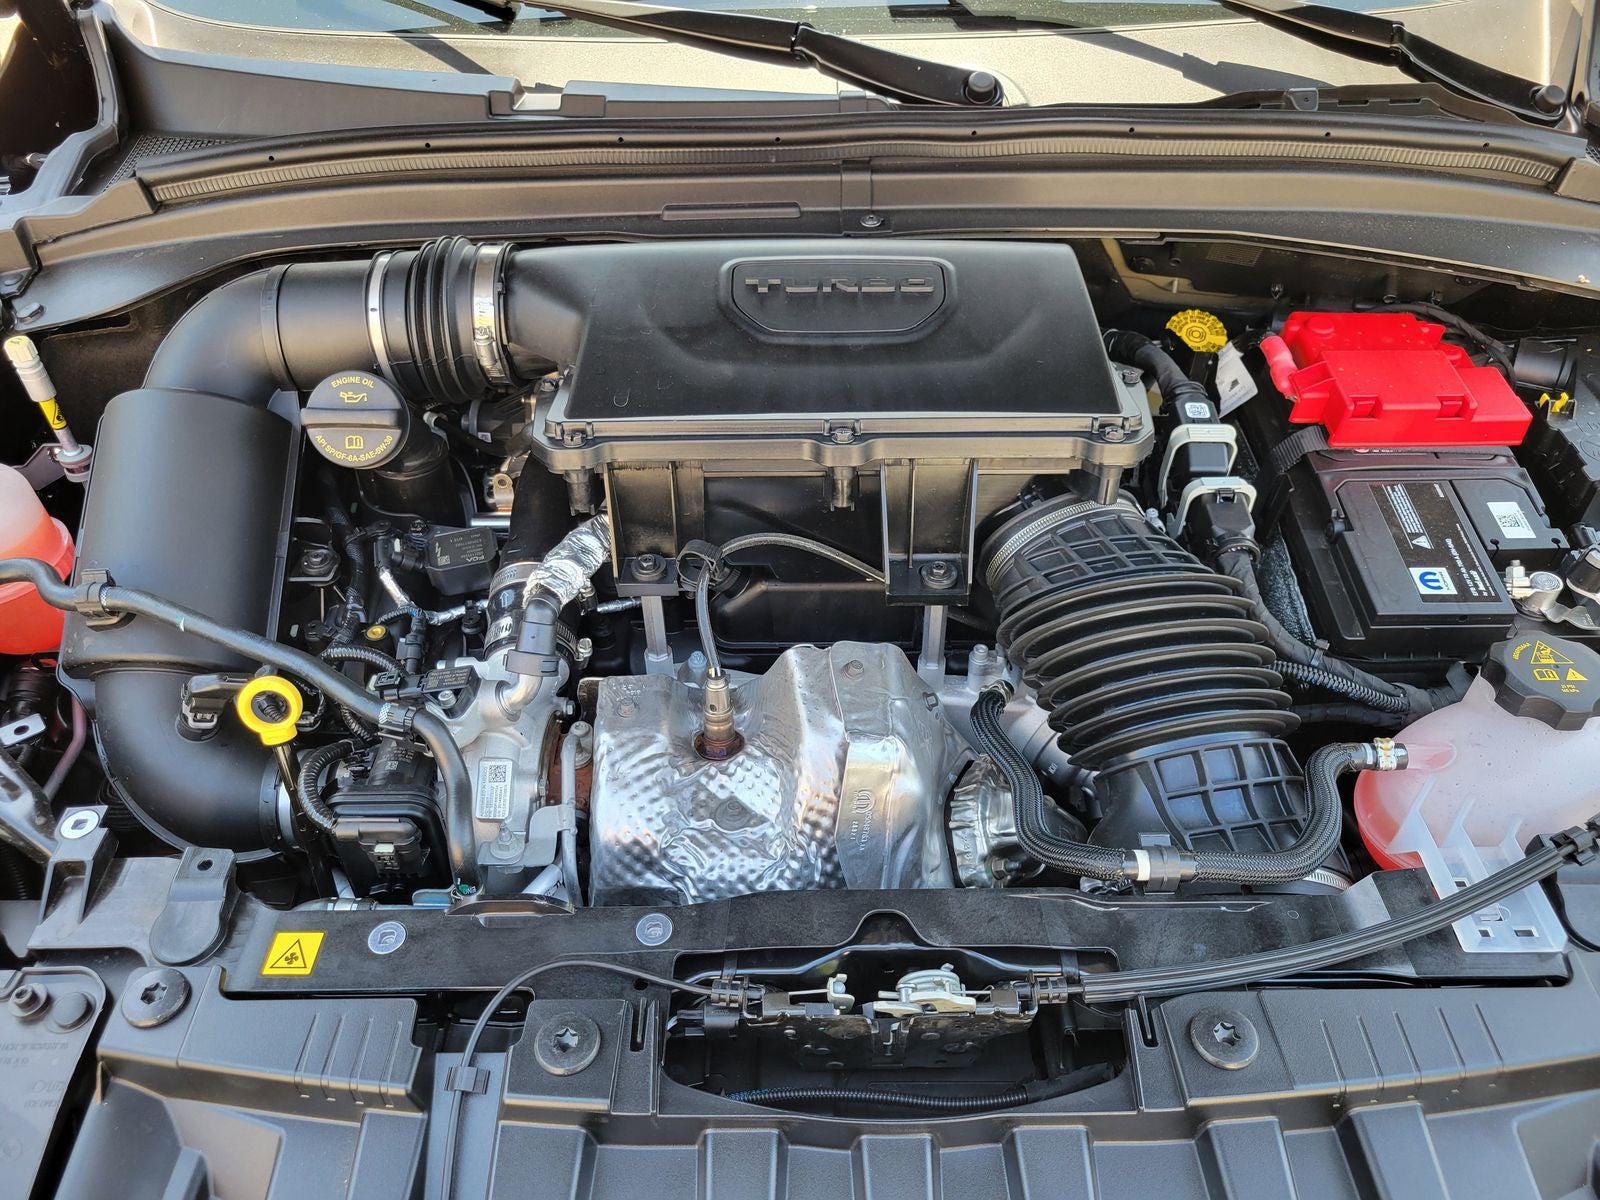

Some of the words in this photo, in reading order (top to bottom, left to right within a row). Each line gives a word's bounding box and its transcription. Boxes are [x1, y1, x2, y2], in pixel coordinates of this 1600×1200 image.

[745, 277, 935, 294] TURBO
[331, 376, 361, 389] ENGINE
[361, 378, 375, 389] OIL
[315, 434, 327, 448] API
[466, 555, 485, 563] FCA
